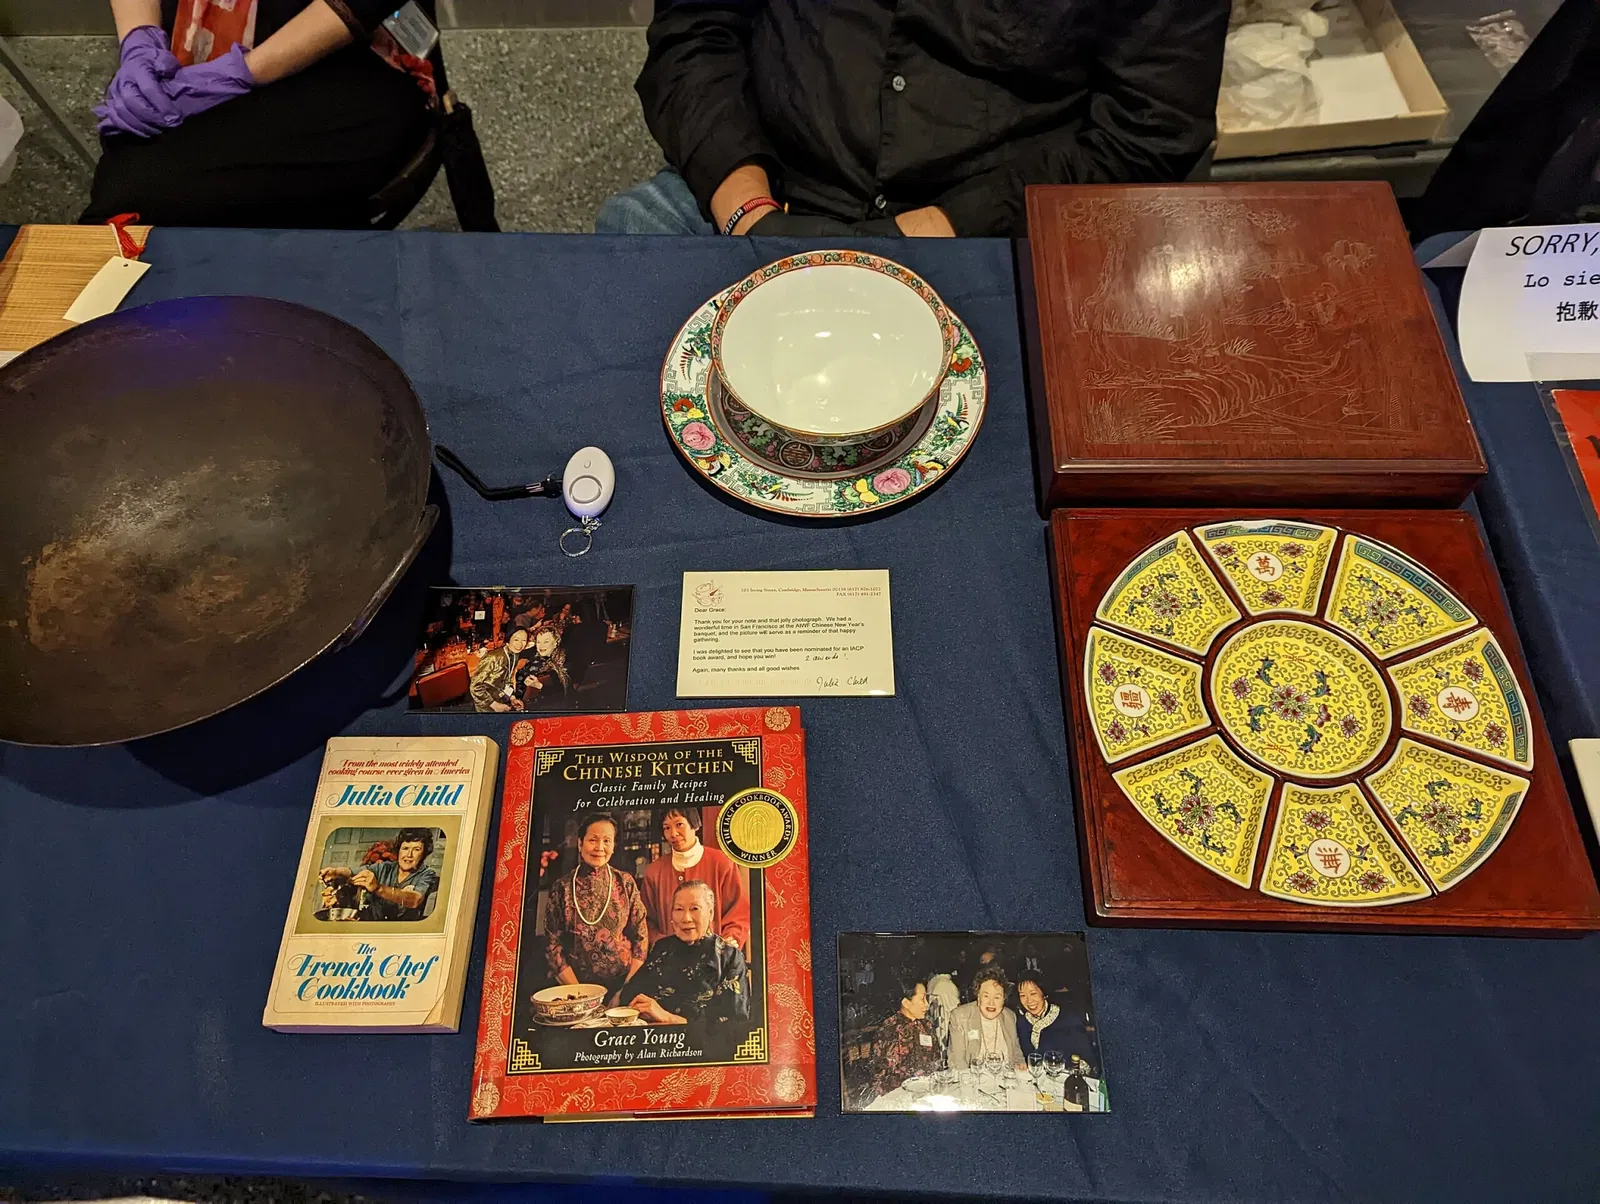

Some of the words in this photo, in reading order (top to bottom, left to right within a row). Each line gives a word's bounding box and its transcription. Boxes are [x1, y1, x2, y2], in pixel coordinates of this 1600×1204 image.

[723, 209, 744, 235] ADOR
[1505, 231, 1600, 256] SORRY,
[1524, 274, 1550, 288] Lo
[1563, 270, 1600, 286] sie
[1556, 300, 1599, 322] 抱歉
[340, 759, 365, 768] From
[366, 758, 378, 767] the
[399, 759, 424, 769] widely
[425, 758, 460, 767] attended
[574, 753, 604, 765] THE
[610, 751, 669, 763] WISDOM
[674, 750, 691, 761] OF
[697, 748, 723, 759] THE
[327, 767, 358, 776] cooking
[404, 768, 425, 777] given
[433, 766, 470, 776] America
[563, 764, 643, 781] CHINESE
[650, 760, 734, 777] KITCHEN
[590, 782, 627, 794] Classic
[632, 780, 667, 793] Family
[672, 778, 708, 789] Recipes
[325, 784, 393, 808] Julia
[394, 784, 464, 808] Child
[573, 798, 591, 811] for
[596, 796, 656, 808] Celebration
[660, 795, 680, 805] and
[684, 792, 725, 804] Healing
[734, 794, 782, 809] COOKBOOK
[723, 806, 734, 826] IACP
[780, 808, 792, 841] AWARDS
[722, 826, 733, 845] THE
[740, 850, 778, 861] WINNER
[351, 941, 377, 955] The
[287, 953, 374, 977] French
[378, 954, 440, 985] Chef
[294, 976, 411, 1002] Cookbook
[594, 1031, 637, 1047] Grace
[642, 1027, 686, 1048] Young
[574, 1051, 622, 1064] Photography
[624, 1051, 634, 1061] by
[636, 1049, 657, 1059] Alan
[659, 1048, 703, 1058] Richardson
